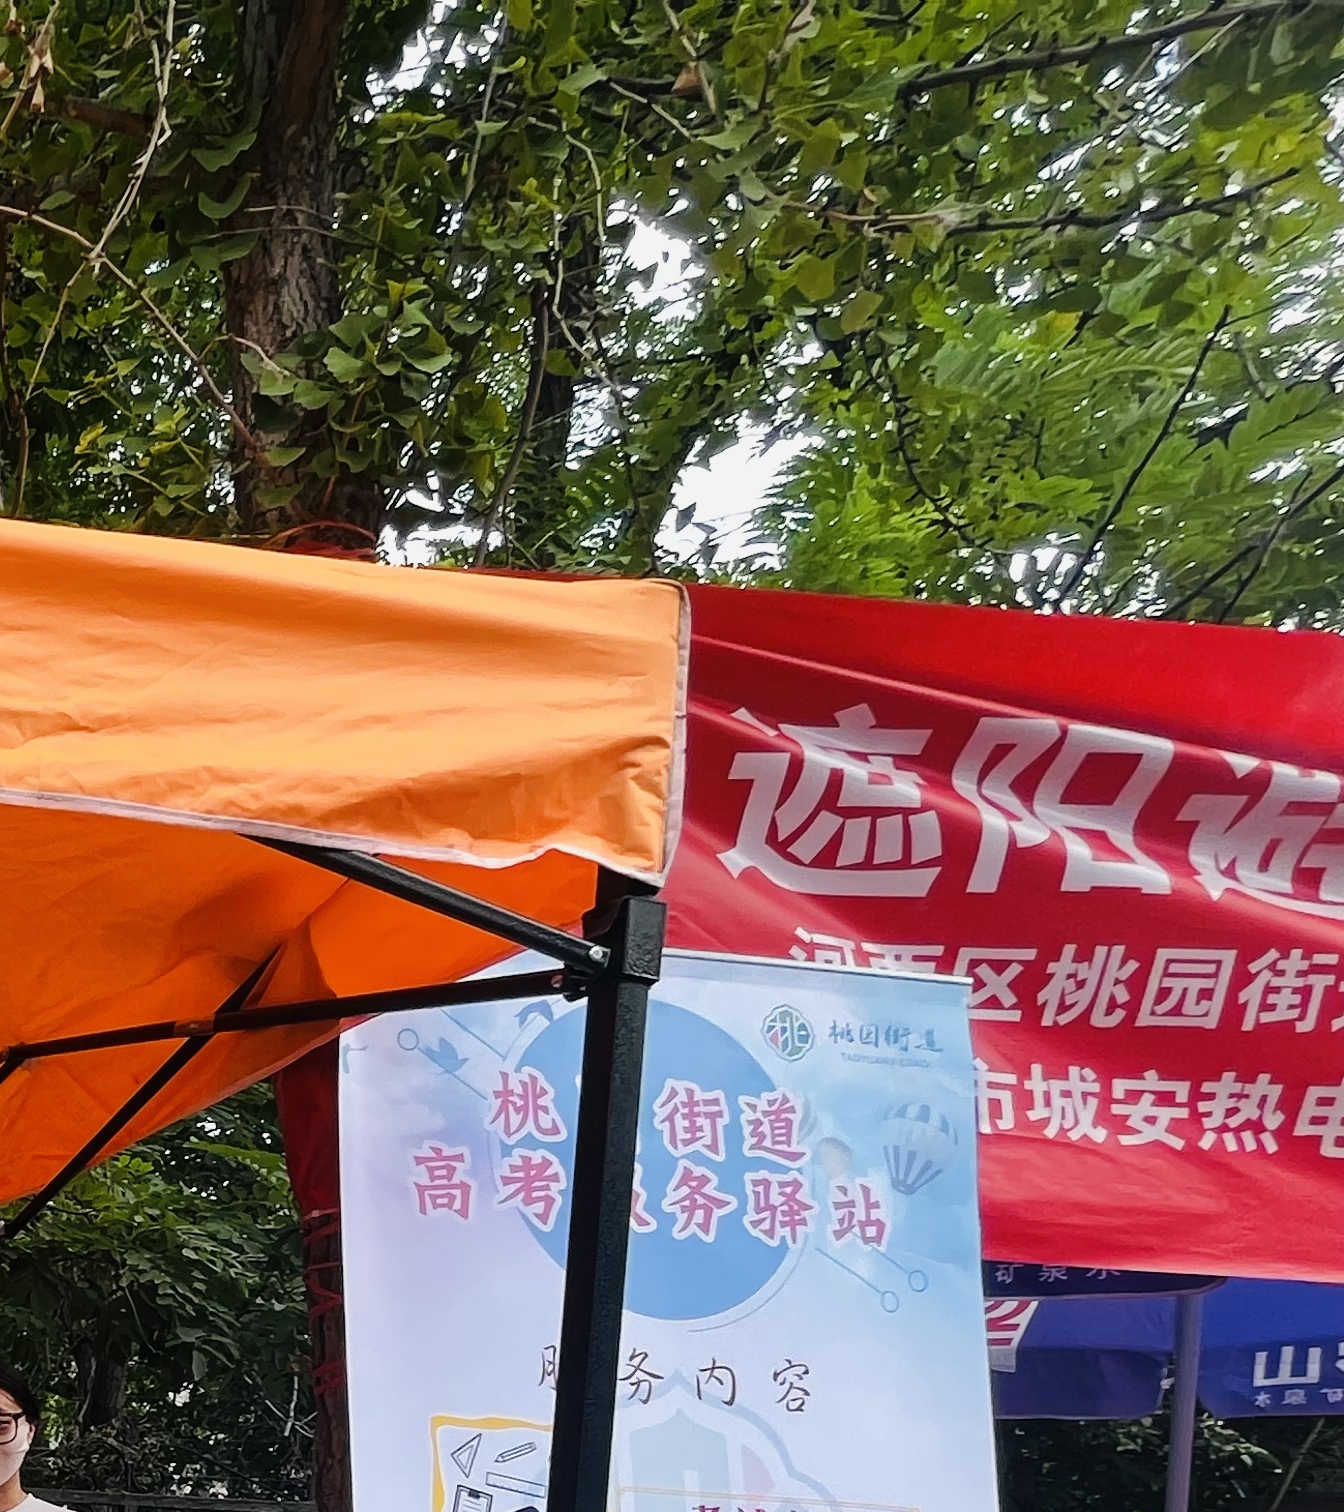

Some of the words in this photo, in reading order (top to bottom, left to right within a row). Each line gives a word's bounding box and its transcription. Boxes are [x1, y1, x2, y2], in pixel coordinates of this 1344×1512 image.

[491, 1070, 806, 1165] 桃街道
[413, 1146, 888, 1247] 高考务驿站
